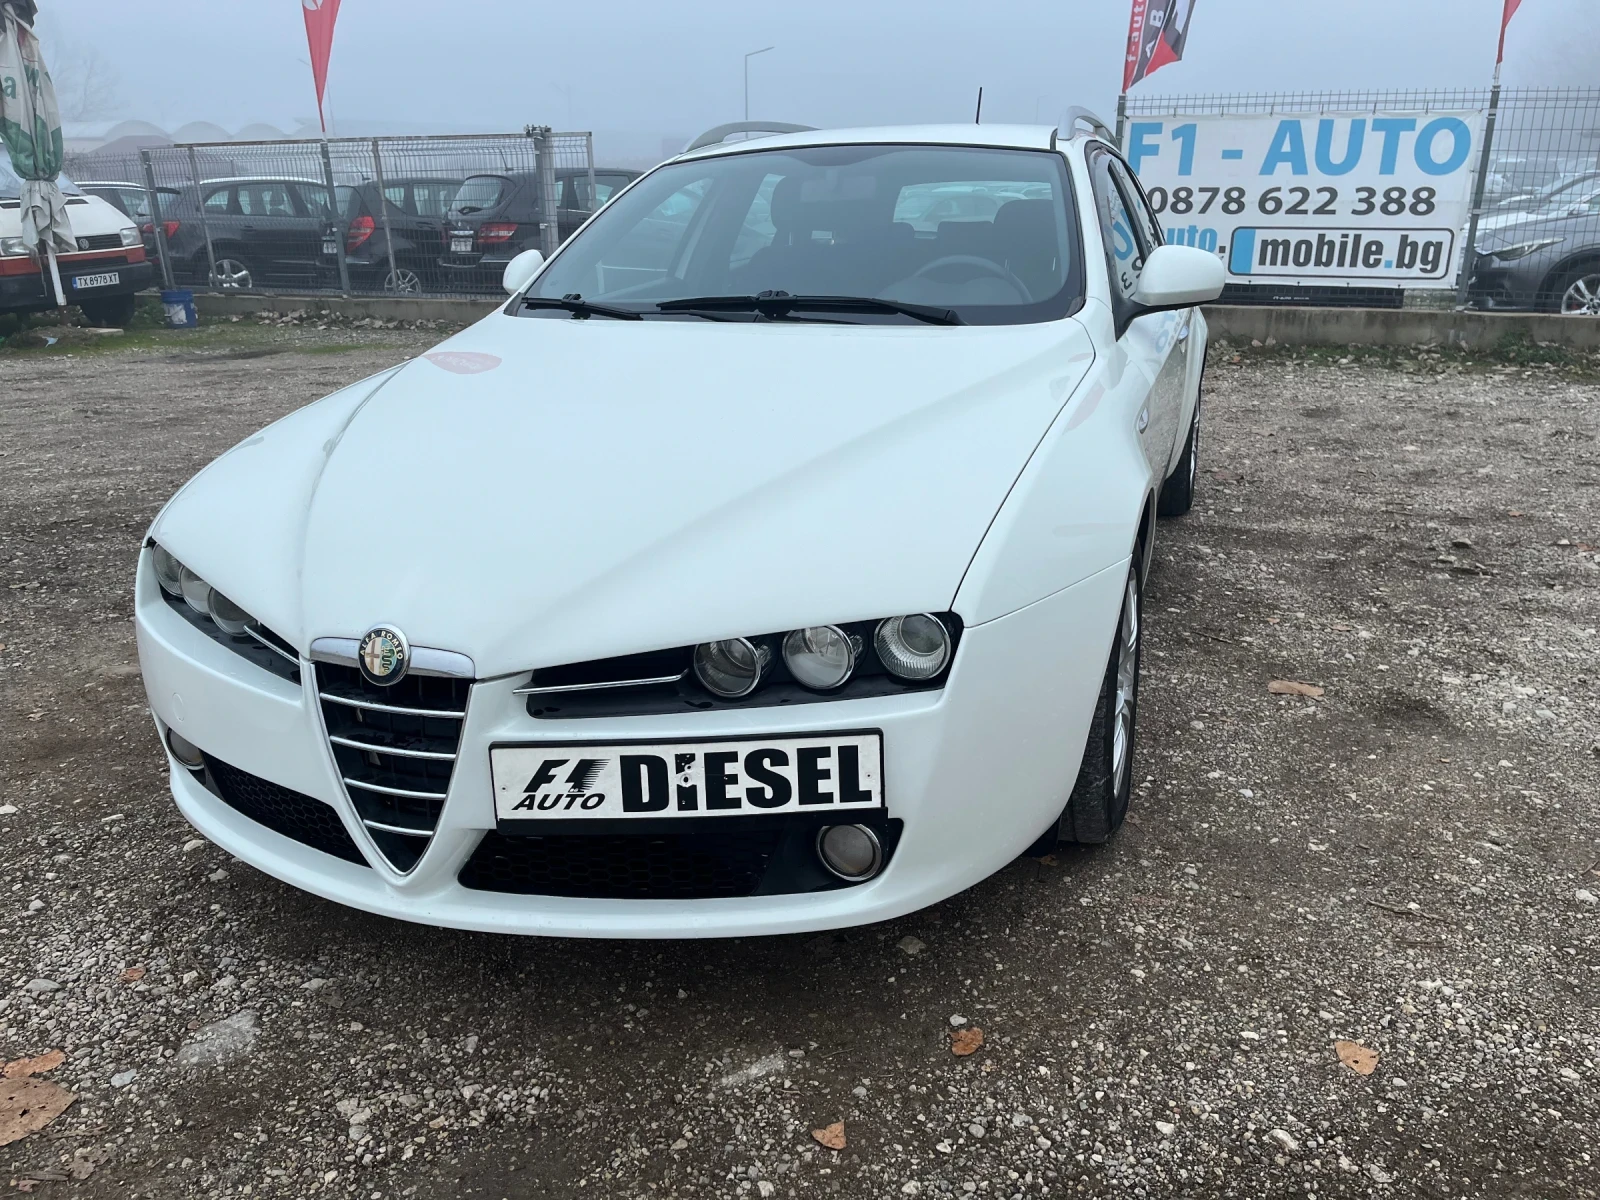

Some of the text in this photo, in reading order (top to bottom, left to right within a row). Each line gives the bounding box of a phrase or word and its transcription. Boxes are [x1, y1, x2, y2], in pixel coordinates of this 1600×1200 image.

[1126, 0, 1145, 62] f-aut
[1127, 122, 1197, 176] F1
[1259, 117, 1472, 176] AUTO
[1147, 186, 1437, 216] 0878 622 388
[1258, 233, 1444, 274] mobile.bg
[360, 630, 403, 660] ALFA ROMEO
[619, 744, 873, 813] DIESEL
[511, 792, 606, 811] AUTO
